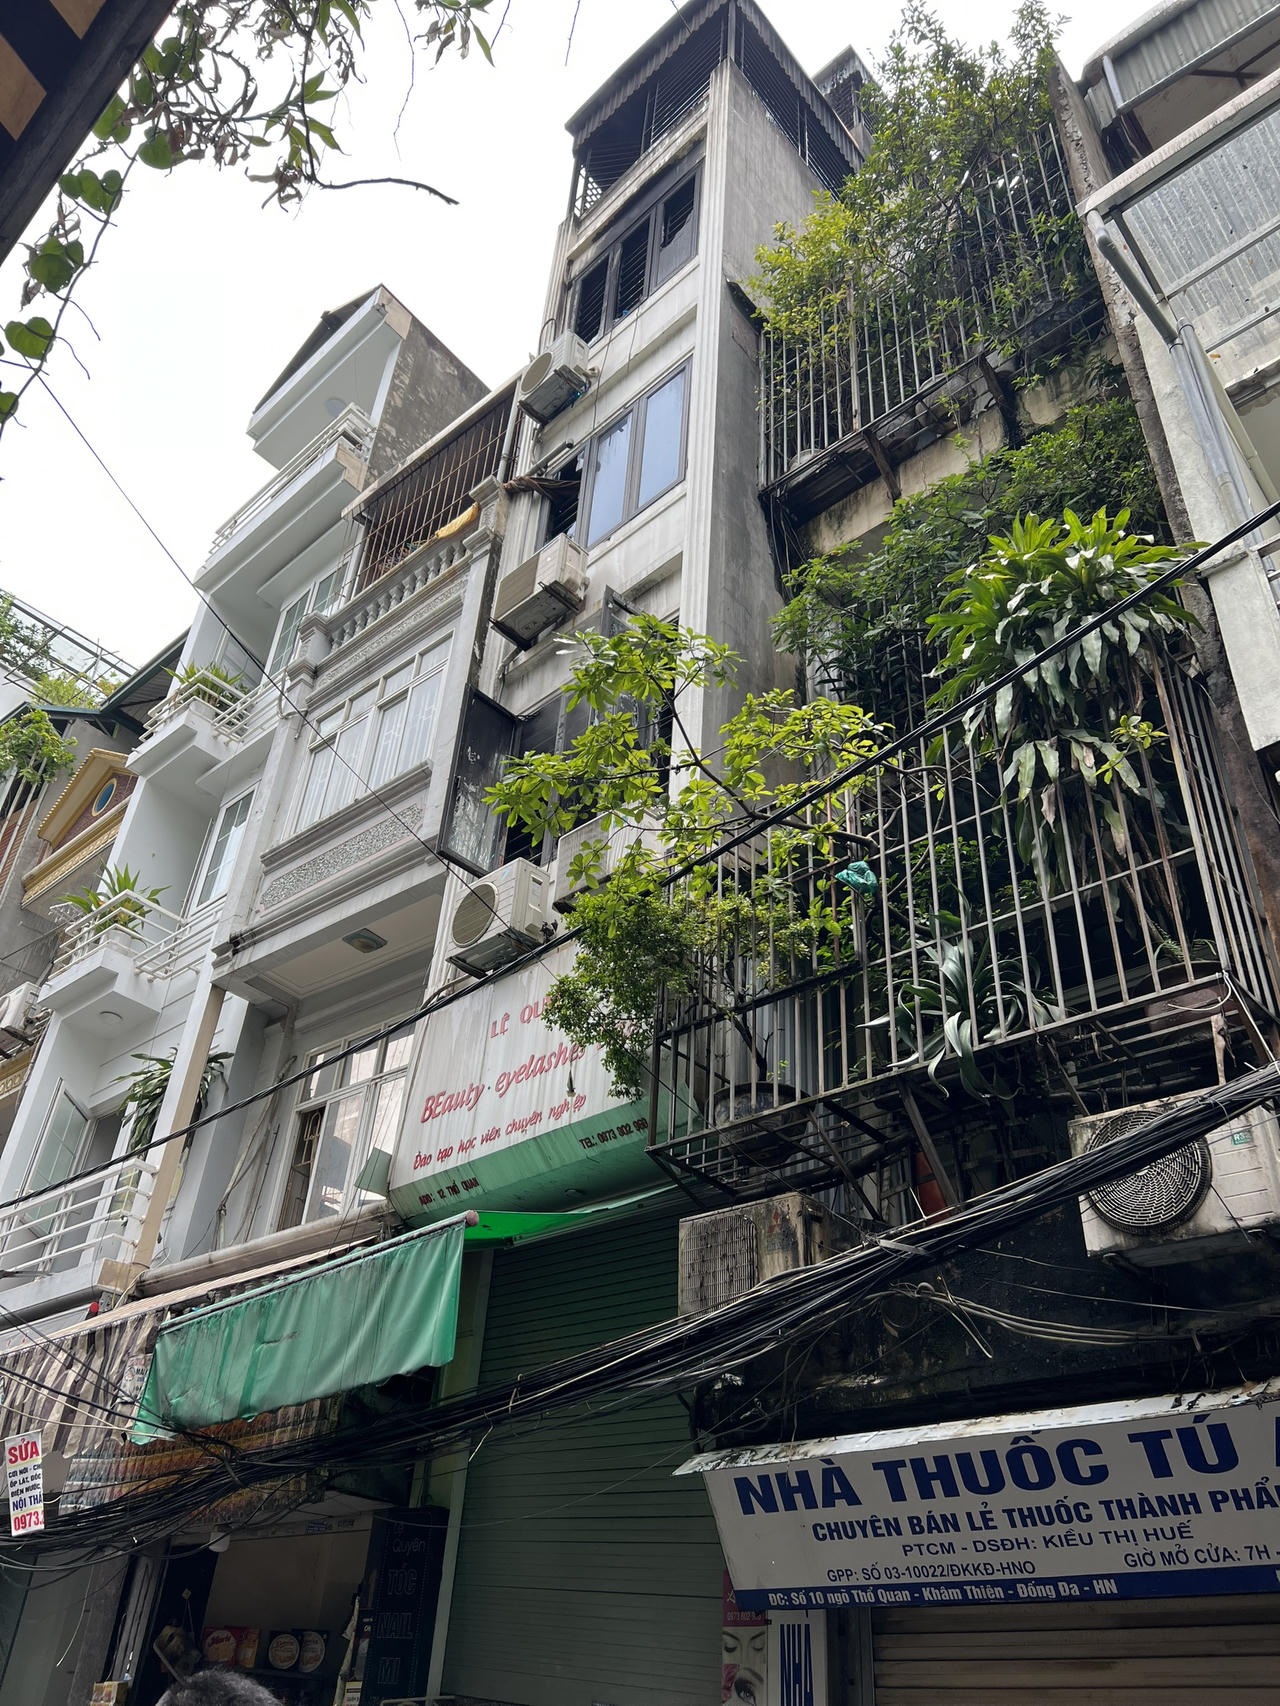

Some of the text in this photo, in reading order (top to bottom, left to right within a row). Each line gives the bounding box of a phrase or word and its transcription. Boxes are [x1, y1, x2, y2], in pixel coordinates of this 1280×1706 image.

[420, 1042, 586, 1124] BEauty eyelashes
[437, 1146, 453, 1163] tạo
[457, 1137, 477, 1155] học
[481, 1126, 501, 1145] viên
[461, 1176, 480, 1192] QUAN
[8, 1437, 40, 1465] SỬA
[733, 1458, 863, 1516] NHÀ
[872, 1429, 1110, 1503] THUỐC
[1127, 1413, 1240, 1479] TÚ
[12, 1496, 27, 1512] NỘI
[811, 1476, 1280, 1542] CHUYÊN BÁN LẺ THUỐC THÀNH PHẨ
[902, 1541, 957, 1557] PTCM
[972, 1536, 1038, 1554] DSĐH:
[1043, 1528, 1094, 1549] KIỀU
[1098, 1529, 1139, 1546] THỊ
[1143, 1519, 1194, 1542] HUẾ
[1124, 1542, 1272, 1568] GIỜ MỞ CỬA: 7H
[827, 1567, 860, 1583] GPP:
[861, 1561, 882, 1582] SỐ
[768, 1592, 789, 1606] ĐC:
[791, 1590, 807, 1605] Số
[808, 1591, 825, 1605] 10
[827, 1588, 850, 1605] ngõ
[850, 1586, 875, 1603] Thổ
[877, 1588, 911, 1604] Quan
[921, 1585, 963, 1602] Khâm
[964, 1584, 1005, 1600] Thiên
[1057, 1581, 1080, 1597] Đa
[1092, 1578, 1118, 1595] HN
[376, 1611, 414, 1640] NAIL
